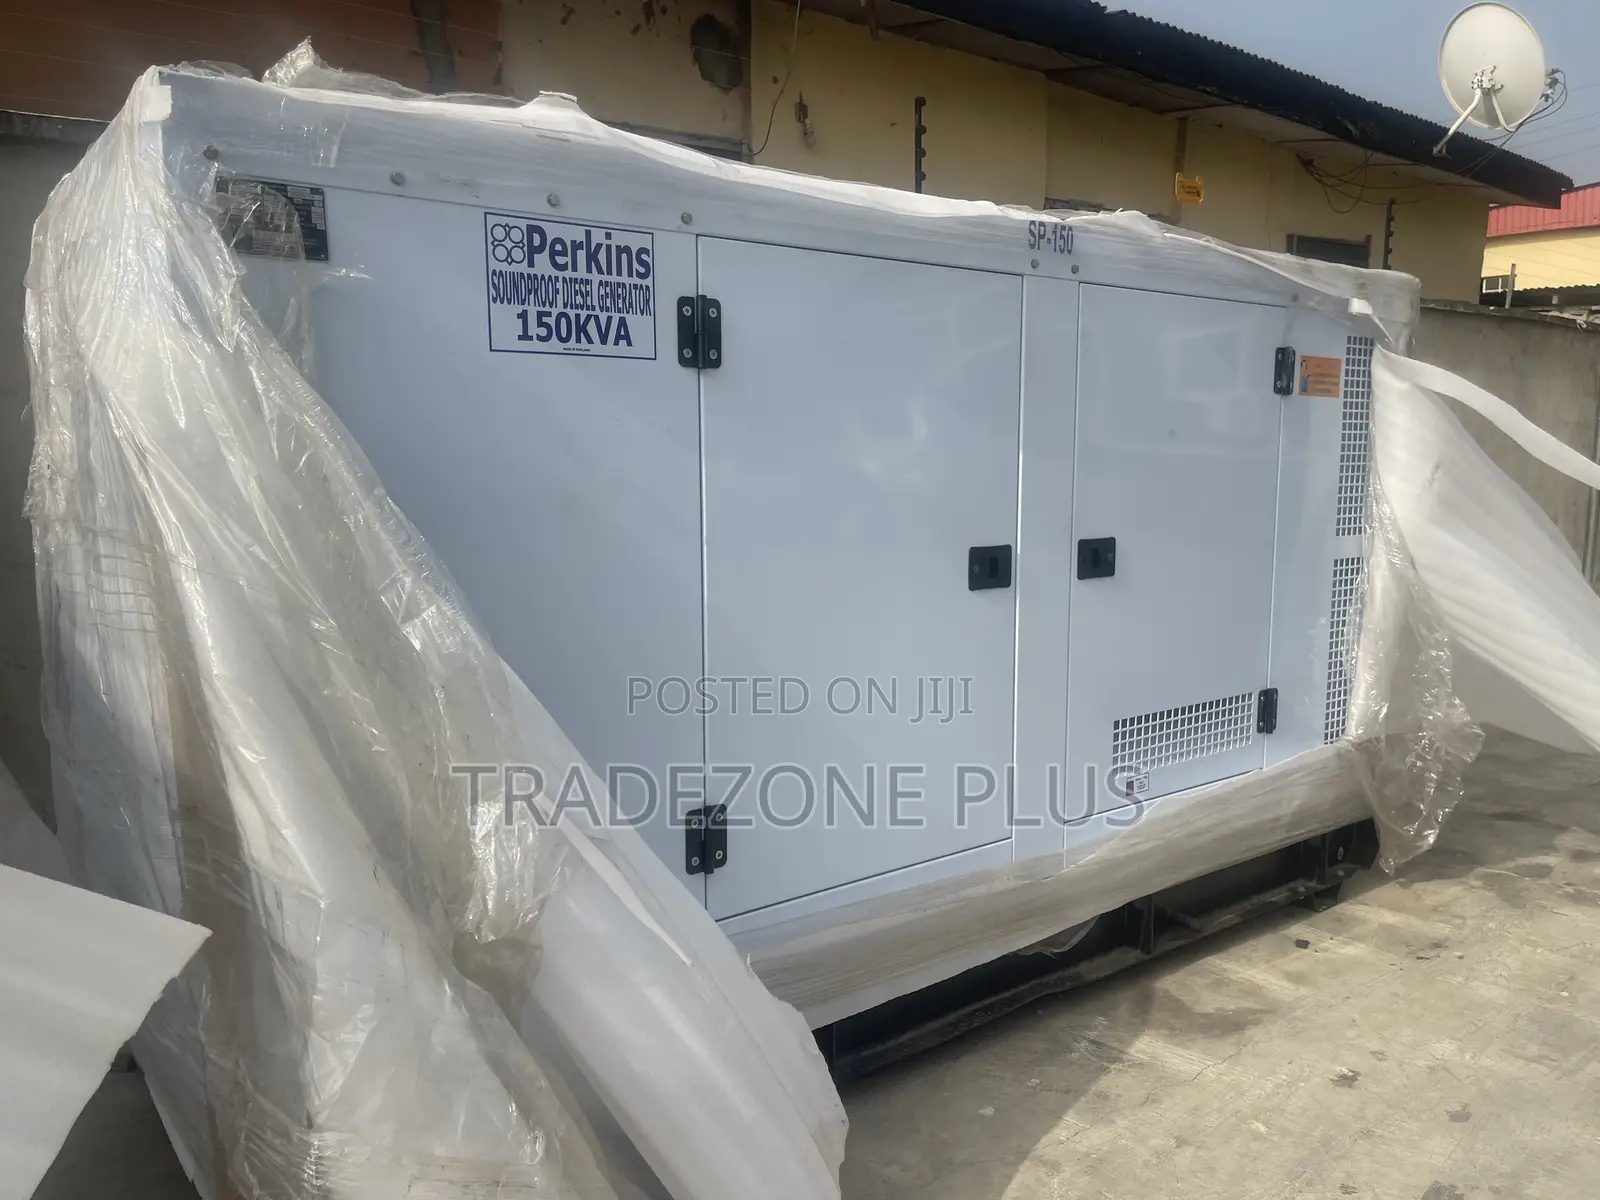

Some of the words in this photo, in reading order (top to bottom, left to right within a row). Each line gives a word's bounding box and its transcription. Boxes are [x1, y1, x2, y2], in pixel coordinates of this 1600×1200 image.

[526, 224, 651, 279] Perkins
[1028, 220, 1074, 255] SP-150
[491, 269, 560, 309] SOUNDPROOF
[562, 276, 596, 311] DIESEL
[598, 280, 652, 316] GENERATOR
[517, 309, 633, 347] 150KVA
